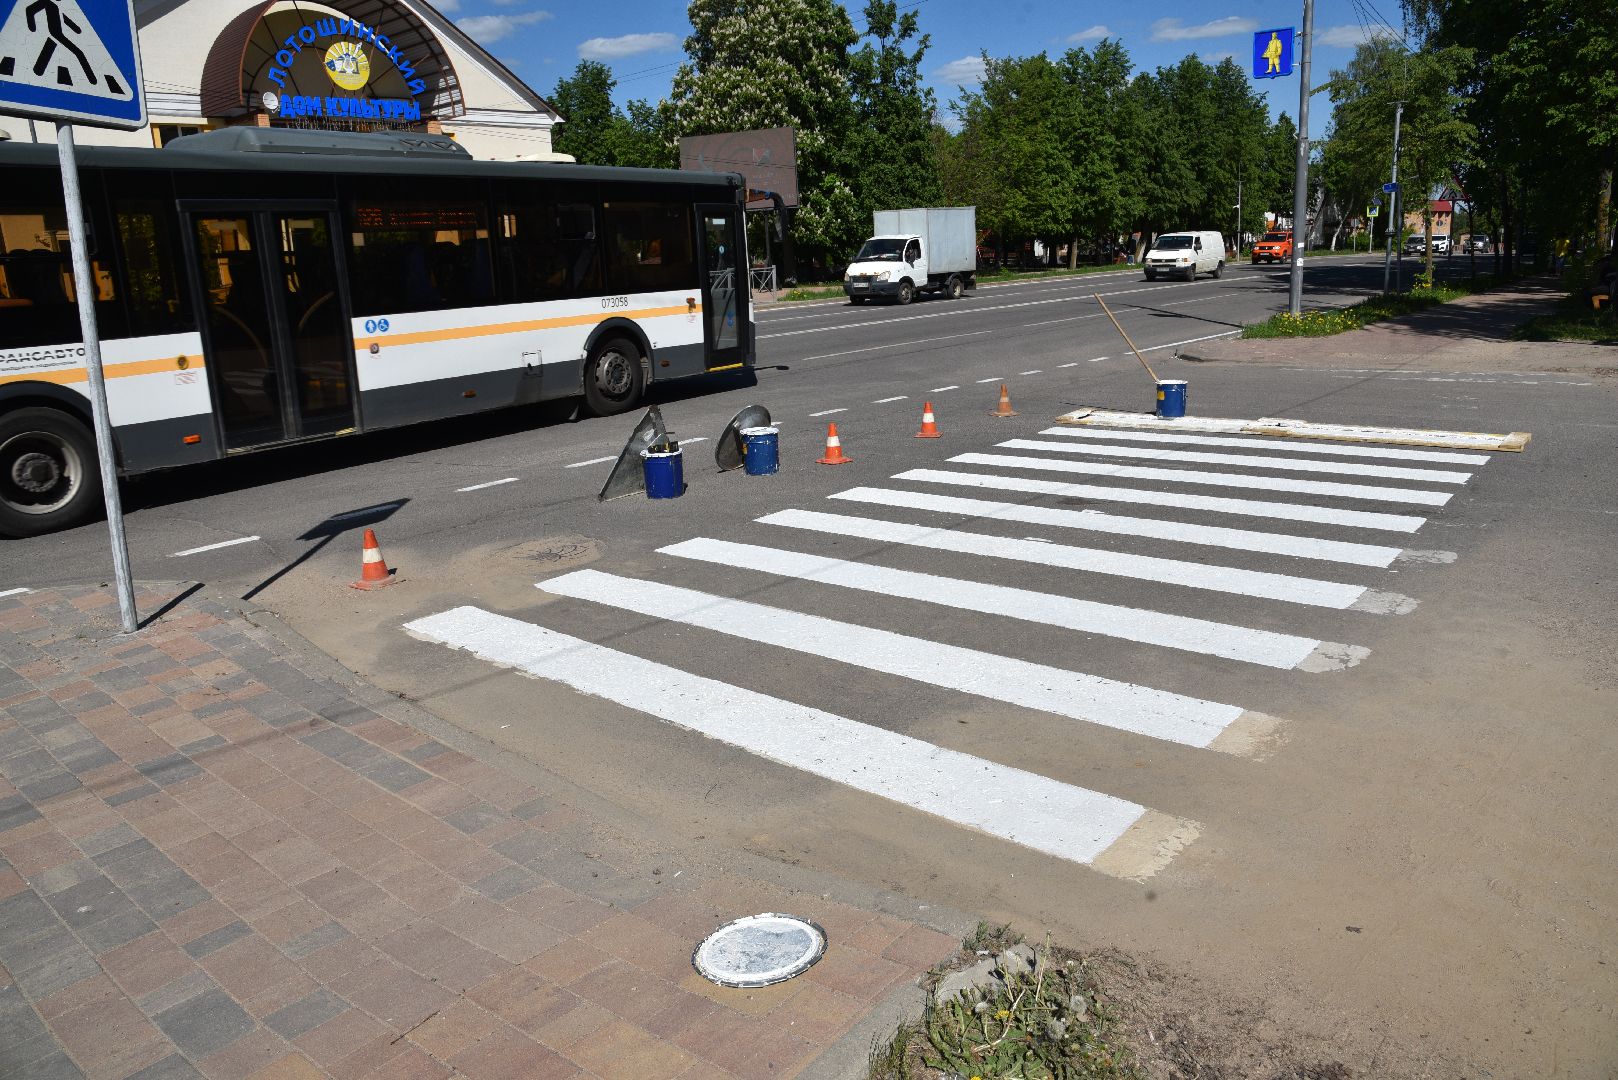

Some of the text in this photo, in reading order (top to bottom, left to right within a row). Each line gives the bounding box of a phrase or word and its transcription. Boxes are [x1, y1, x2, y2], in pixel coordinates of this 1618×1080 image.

[268, 17, 427, 95] ЛОТОШИНСКИЙ
[279, 94, 421, 120] ДОМ КУЛЬТУРЫ
[601, 296, 629, 309] 073058
